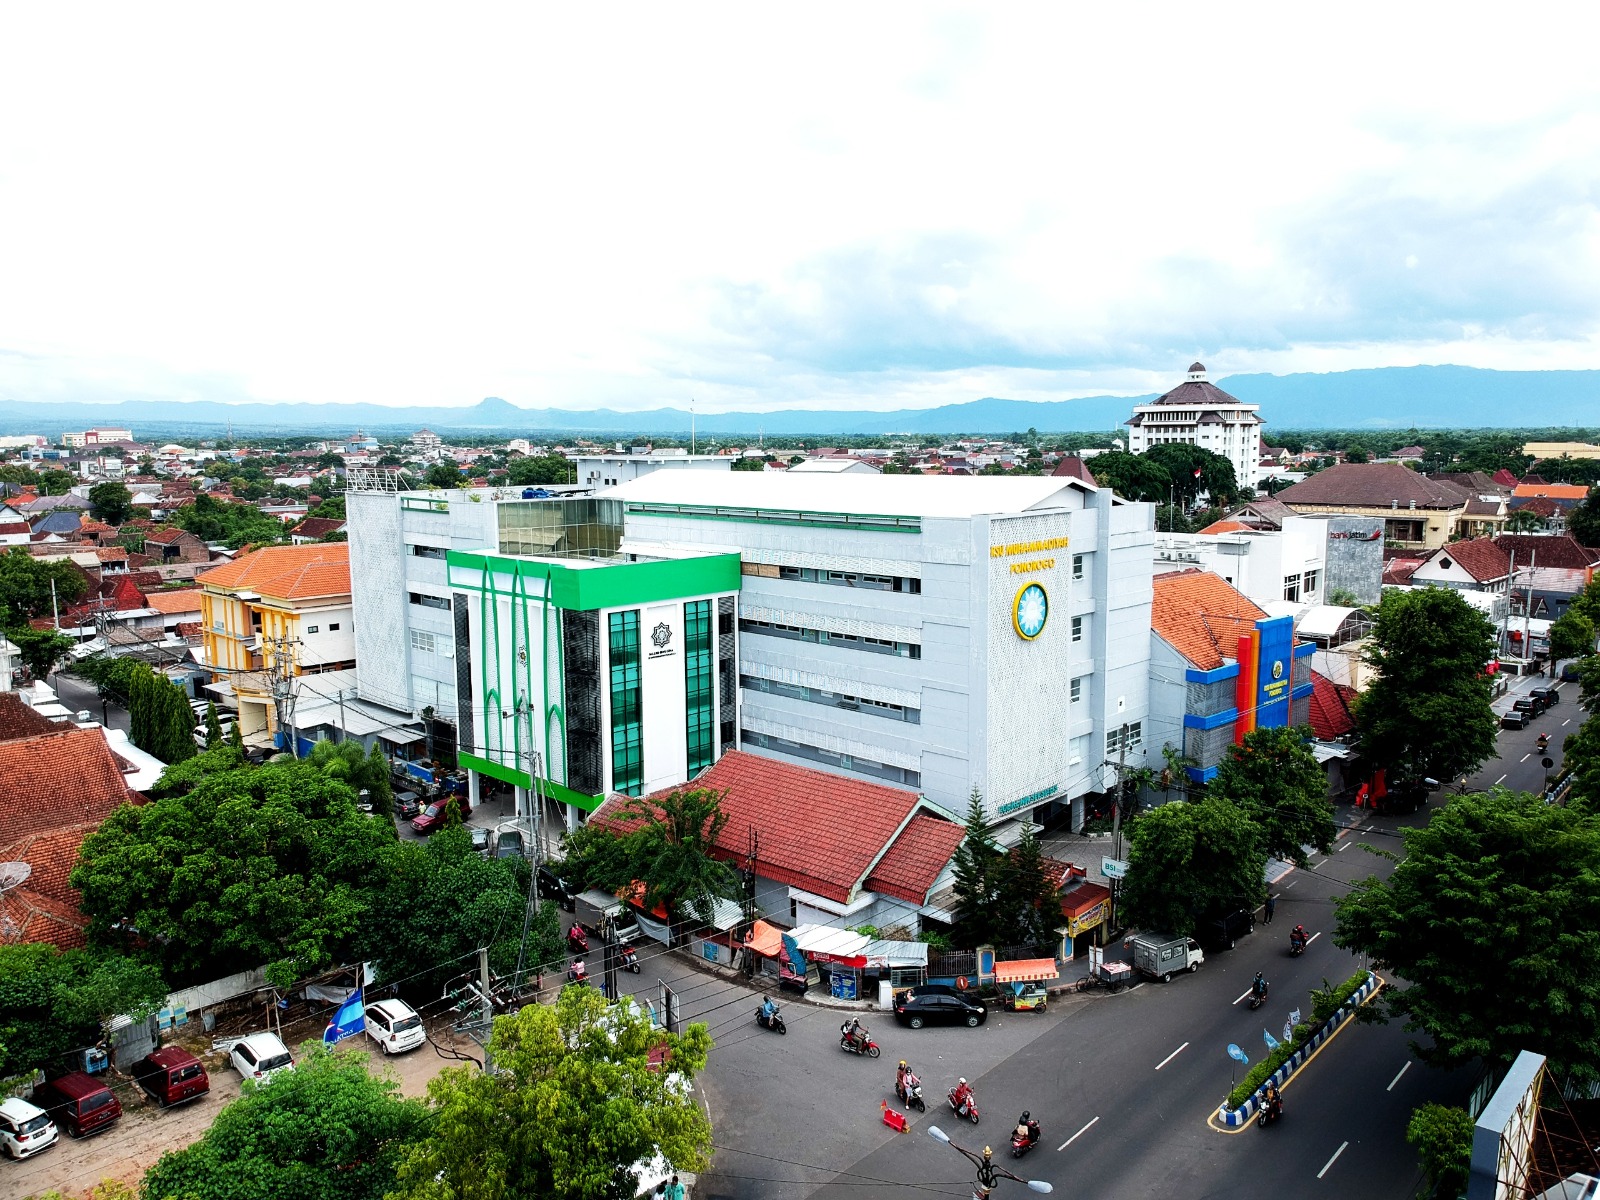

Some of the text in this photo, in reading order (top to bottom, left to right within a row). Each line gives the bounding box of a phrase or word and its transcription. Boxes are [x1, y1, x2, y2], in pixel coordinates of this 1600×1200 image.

[1330, 531, 1367, 540] bank jatim
[1005, 537, 1069, 556] MUHAMMADIYAH
[1010, 558, 1056, 575] PONOROGO
[1104, 863, 1116, 872] BSI
